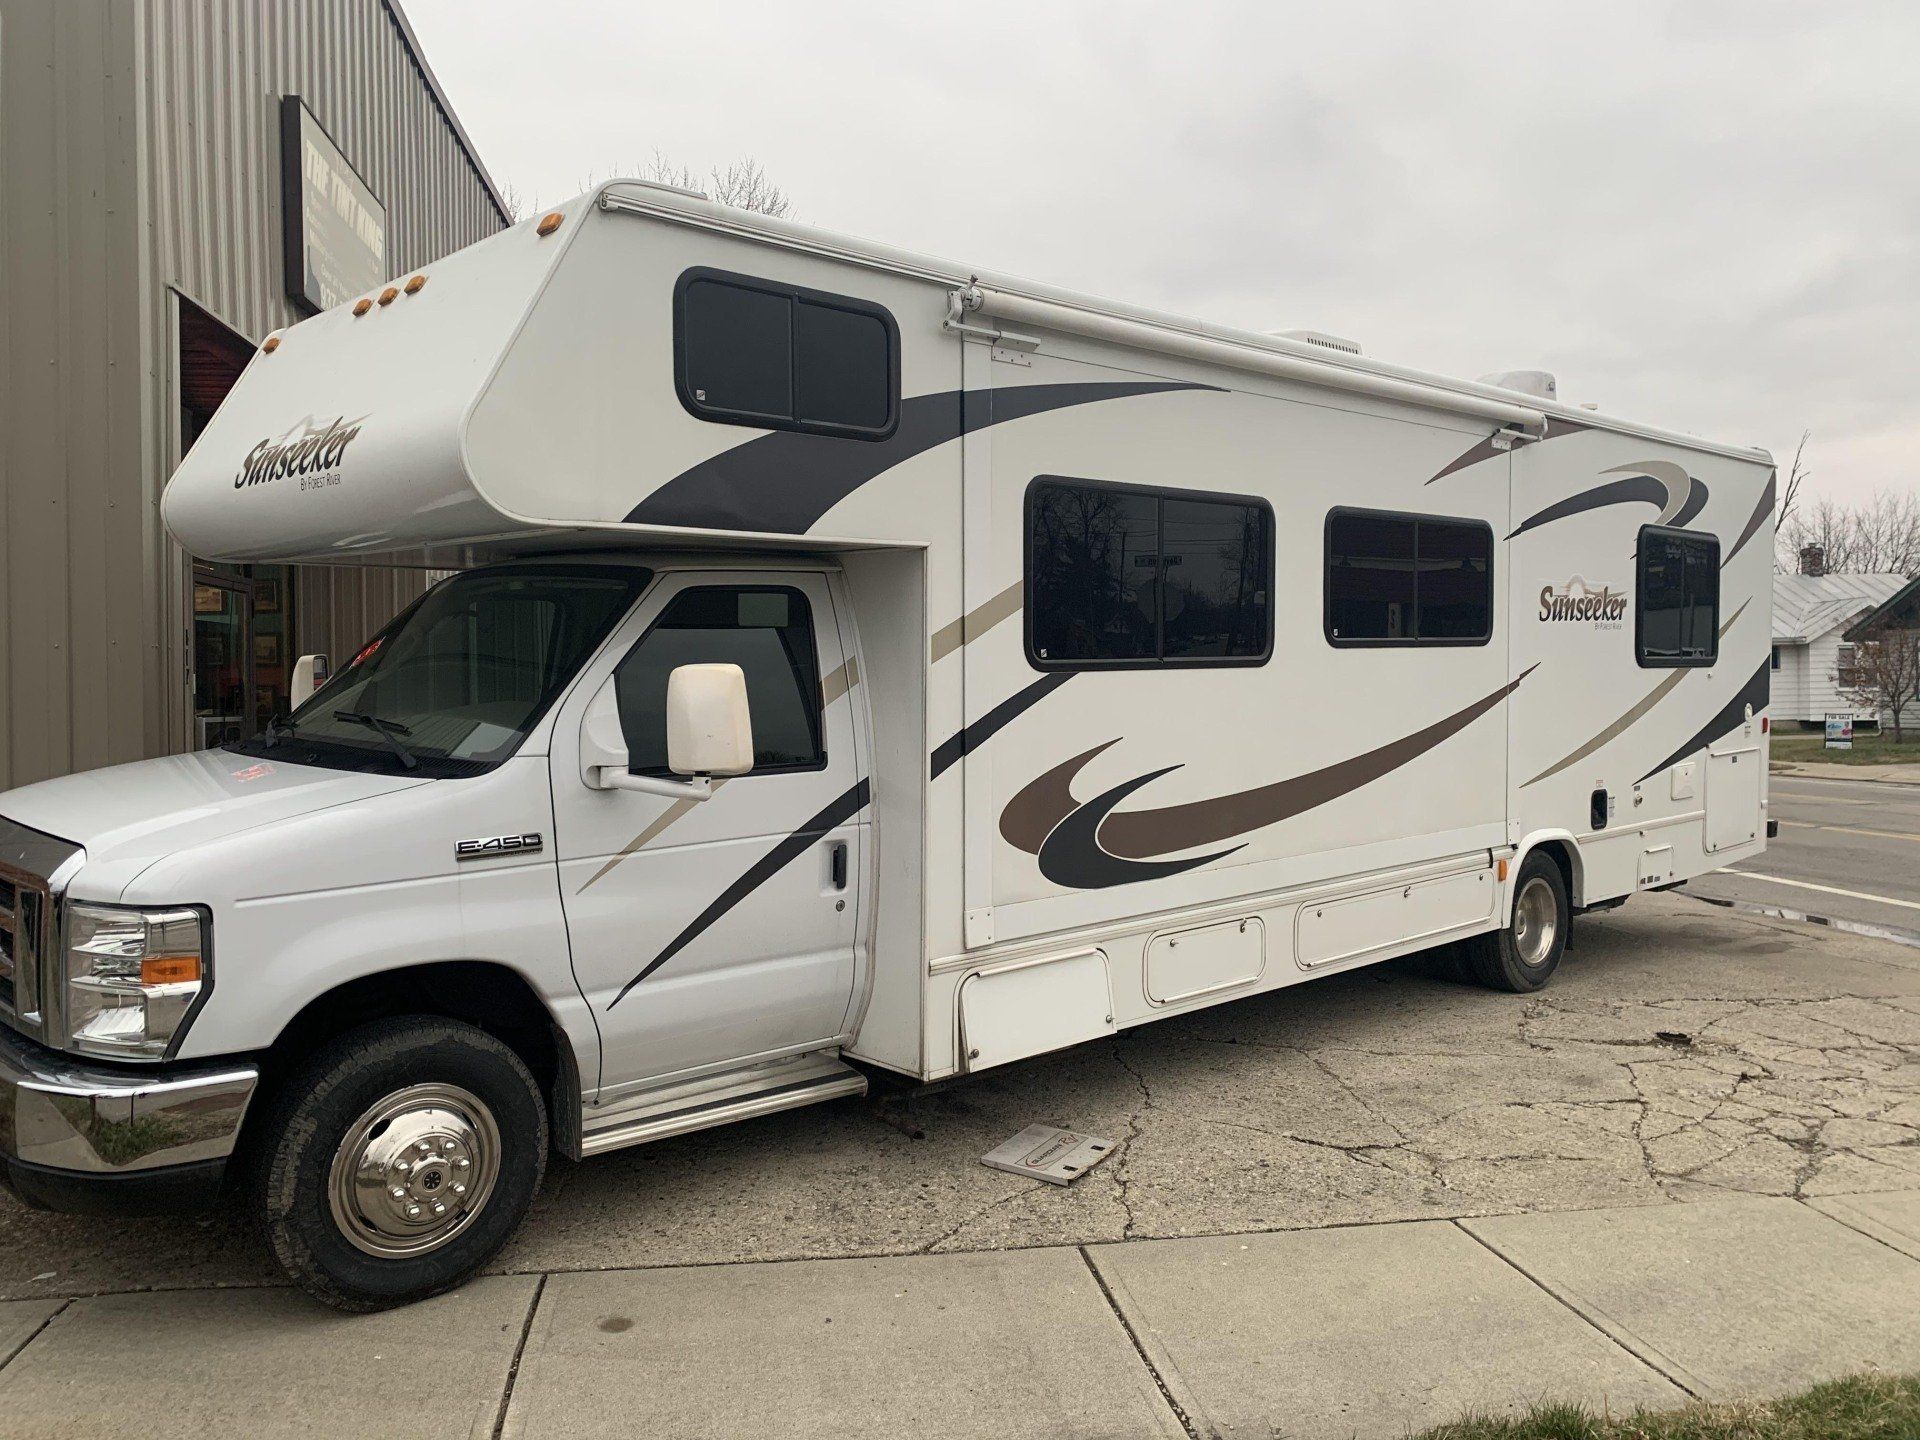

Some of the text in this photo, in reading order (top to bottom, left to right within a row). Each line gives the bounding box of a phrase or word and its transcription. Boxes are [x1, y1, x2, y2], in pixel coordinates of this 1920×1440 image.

[306, 139, 330, 199] THE
[331, 169, 357, 229] TINT
[357, 203, 383, 261] KING
[235, 416, 361, 489] Sunseeker
[308, 477, 325, 490] FOREST
[327, 473, 341, 486] RIVER
[1539, 585, 1627, 621] Sunseeker
[457, 833, 543, 855] E-450
